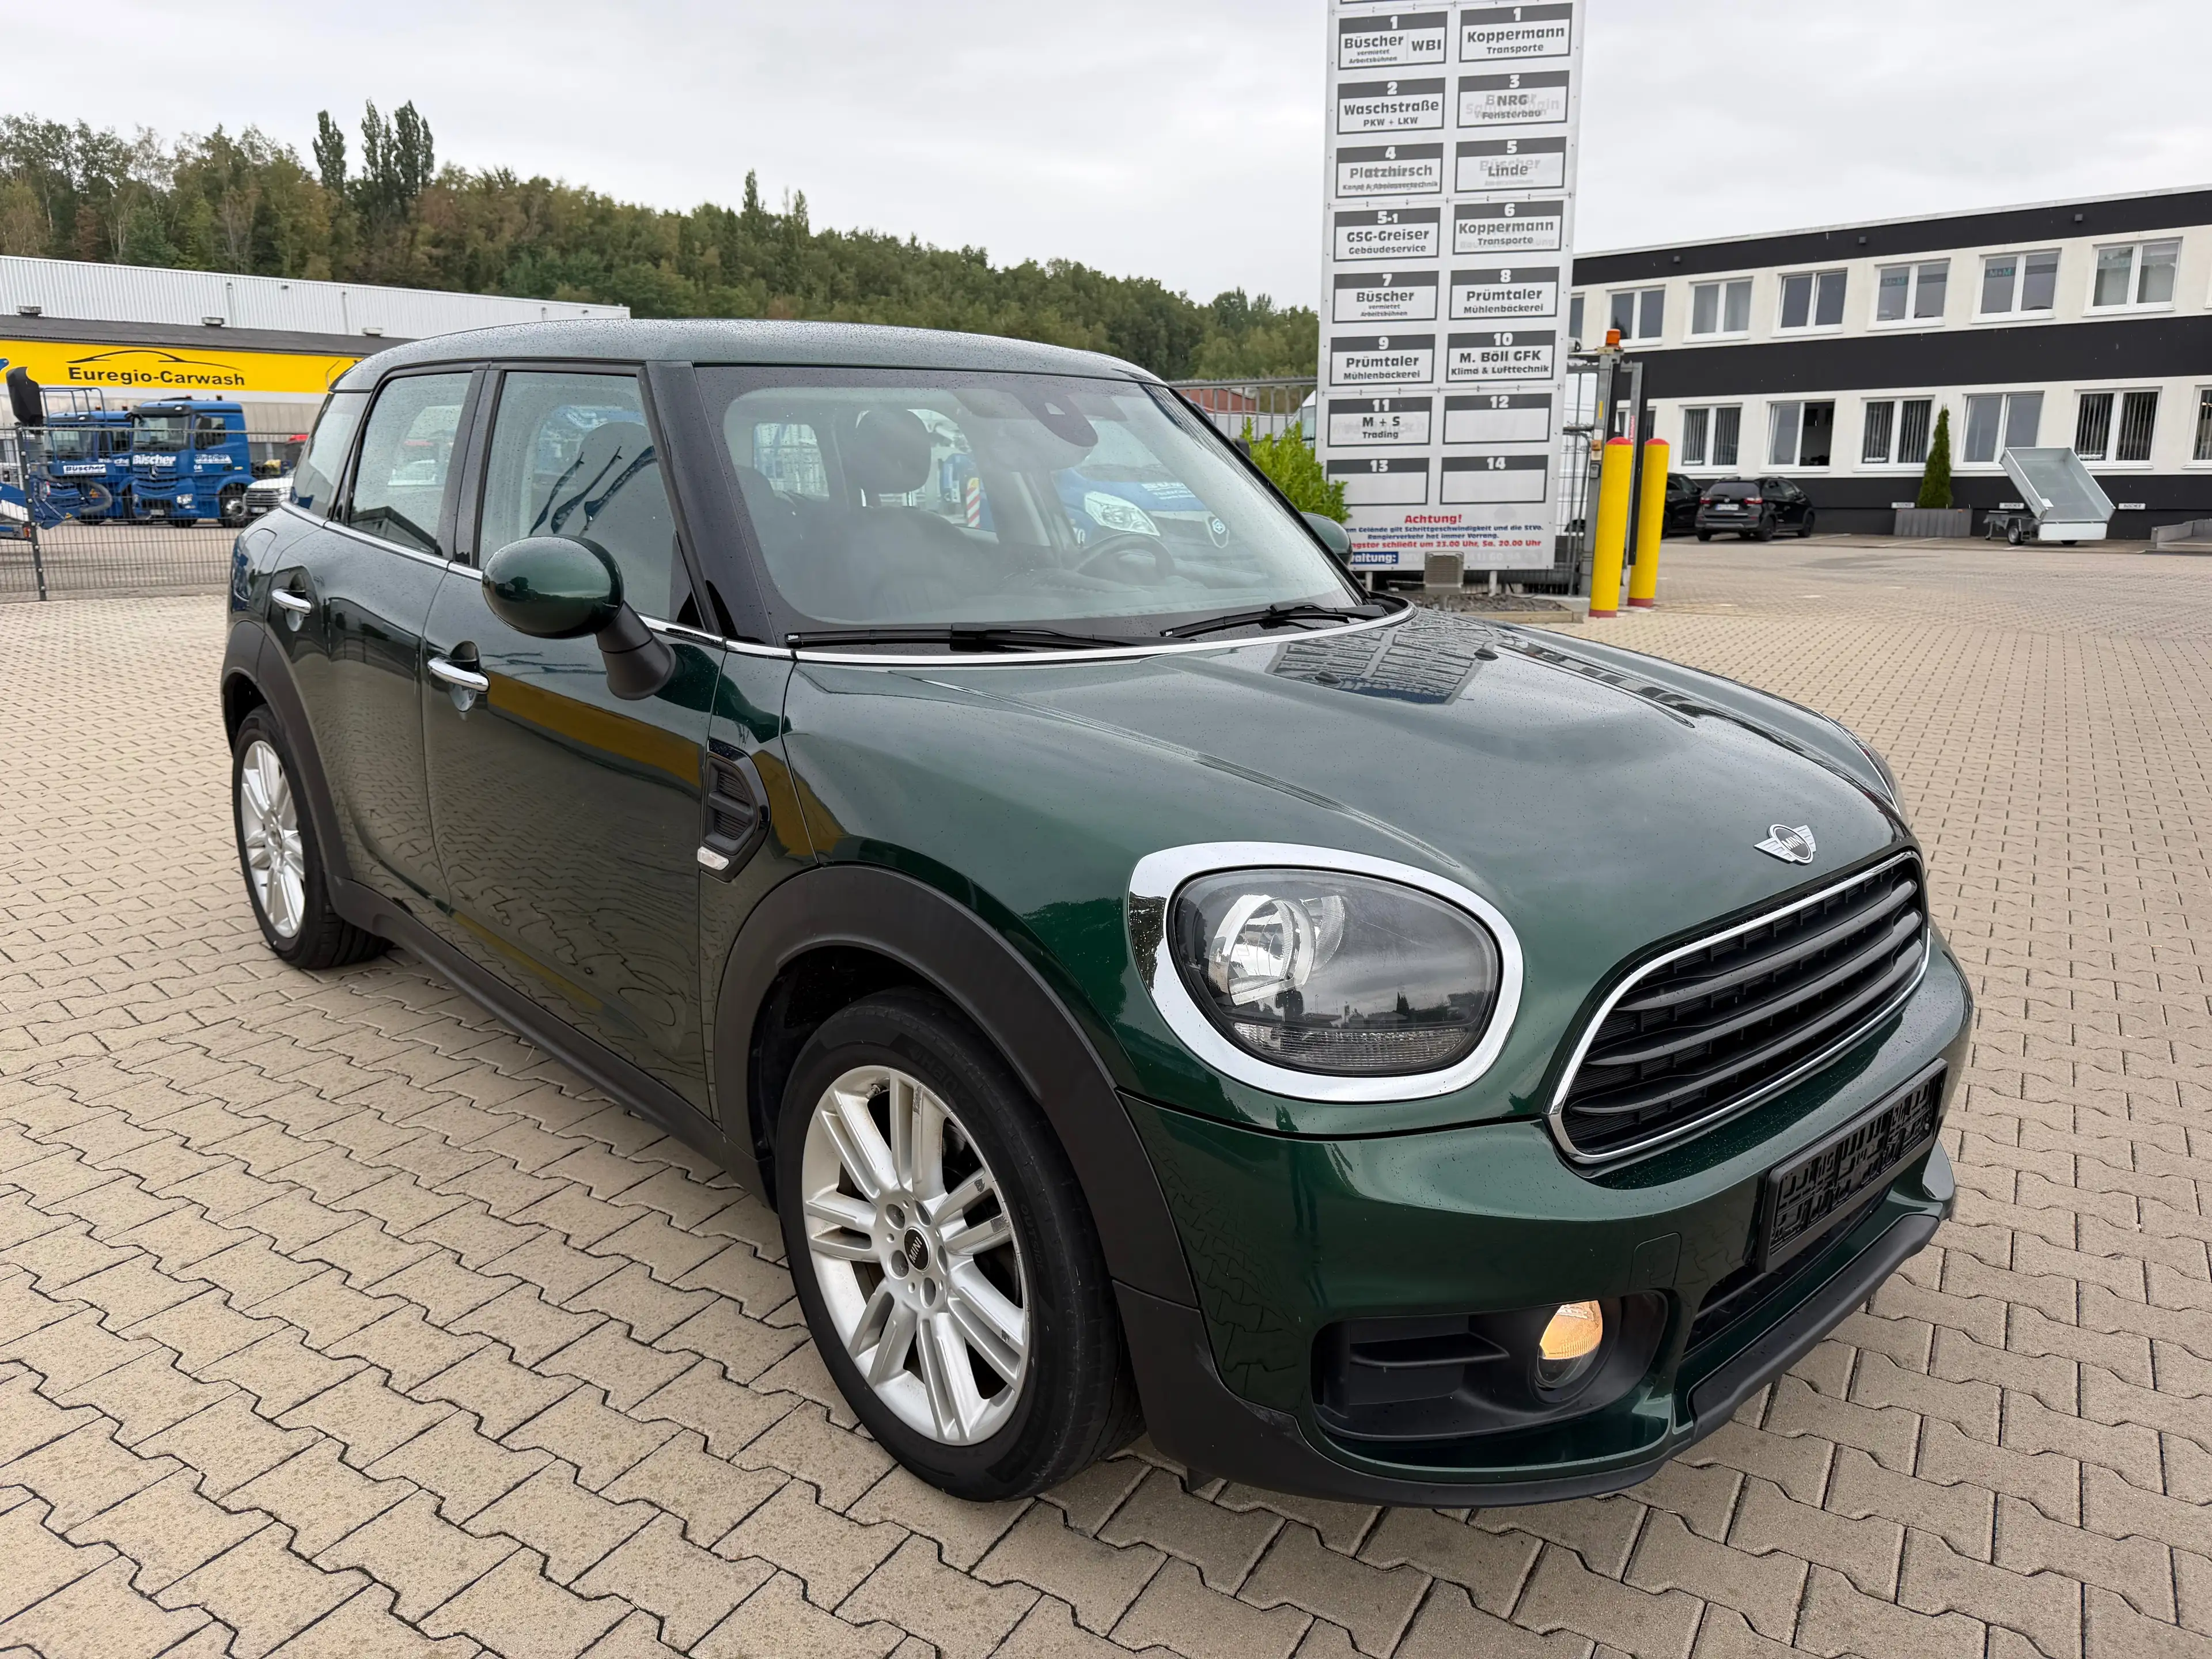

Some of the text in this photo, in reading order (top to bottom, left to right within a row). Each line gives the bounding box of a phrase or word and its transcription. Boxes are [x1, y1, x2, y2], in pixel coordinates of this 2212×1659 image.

[1513, 7, 1521, 21] 1
[1390, 16, 1398, 29] 1
[1467, 27, 1565, 43] Koppermann
[1344, 36, 1442, 51] Büscher WBI
[1487, 44, 1544, 54] Transporte
[1509, 74, 1520, 88] 3
[1387, 81, 1398, 95] 2
[1497, 94, 1527, 107] NRG
[1344, 100, 1439, 115] Waschstraße
[1482, 109, 1541, 120] Fensterbau
[1363, 119, 1385, 127] PKW
[1398, 117, 1418, 125] LKW
[1385, 146, 1396, 160] 4
[1506, 140, 1517, 154] 5
[1350, 165, 1432, 179] Platzhirsch
[1488, 164, 1529, 177] Linde
[1504, 203, 1516, 217] 6
[1377, 211, 1399, 224] 5-1
[1459, 221, 1554, 236] Koppermann
[1347, 229, 1430, 243] GSG-Greiser
[1478, 237, 1533, 246] Transporte
[1349, 245, 1426, 255] Gebäudeservice
[1382, 274, 1393, 287] 7
[1500, 269, 1512, 283] 8
[1356, 290, 1415, 302] Büscher
[1467, 289, 1543, 302] Prümtaler
[1464, 304, 1544, 314] Mühlenbäckerei
[1378, 336, 1389, 350] 9
[1493, 332, 1513, 346] 10
[1346, 355, 1419, 368] Prümtaler
[1460, 350, 1541, 363] M. Böll GFK
[68, 366, 245, 386] Euregio-Carwash
[1343, 370, 1421, 380] Mühlenbäckerei
[1451, 367, 1479, 376] Klima
[1491, 365, 1550, 374] Lufttechnik
[1372, 399, 1389, 412] 11
[1490, 395, 1509, 408] 12
[1362, 416, 1374, 427] M
[1392, 416, 1400, 426] S
[1362, 431, 1399, 440] Trading
[1370, 460, 1389, 472] 13
[1487, 457, 1506, 469] 14
[1404, 514, 1463, 525] Achtung!
[1781, 834, 1806, 851] MINI
[1020, 1203, 1045, 1275] OUTSIDE
[908, 1236, 923, 1263] MINI
